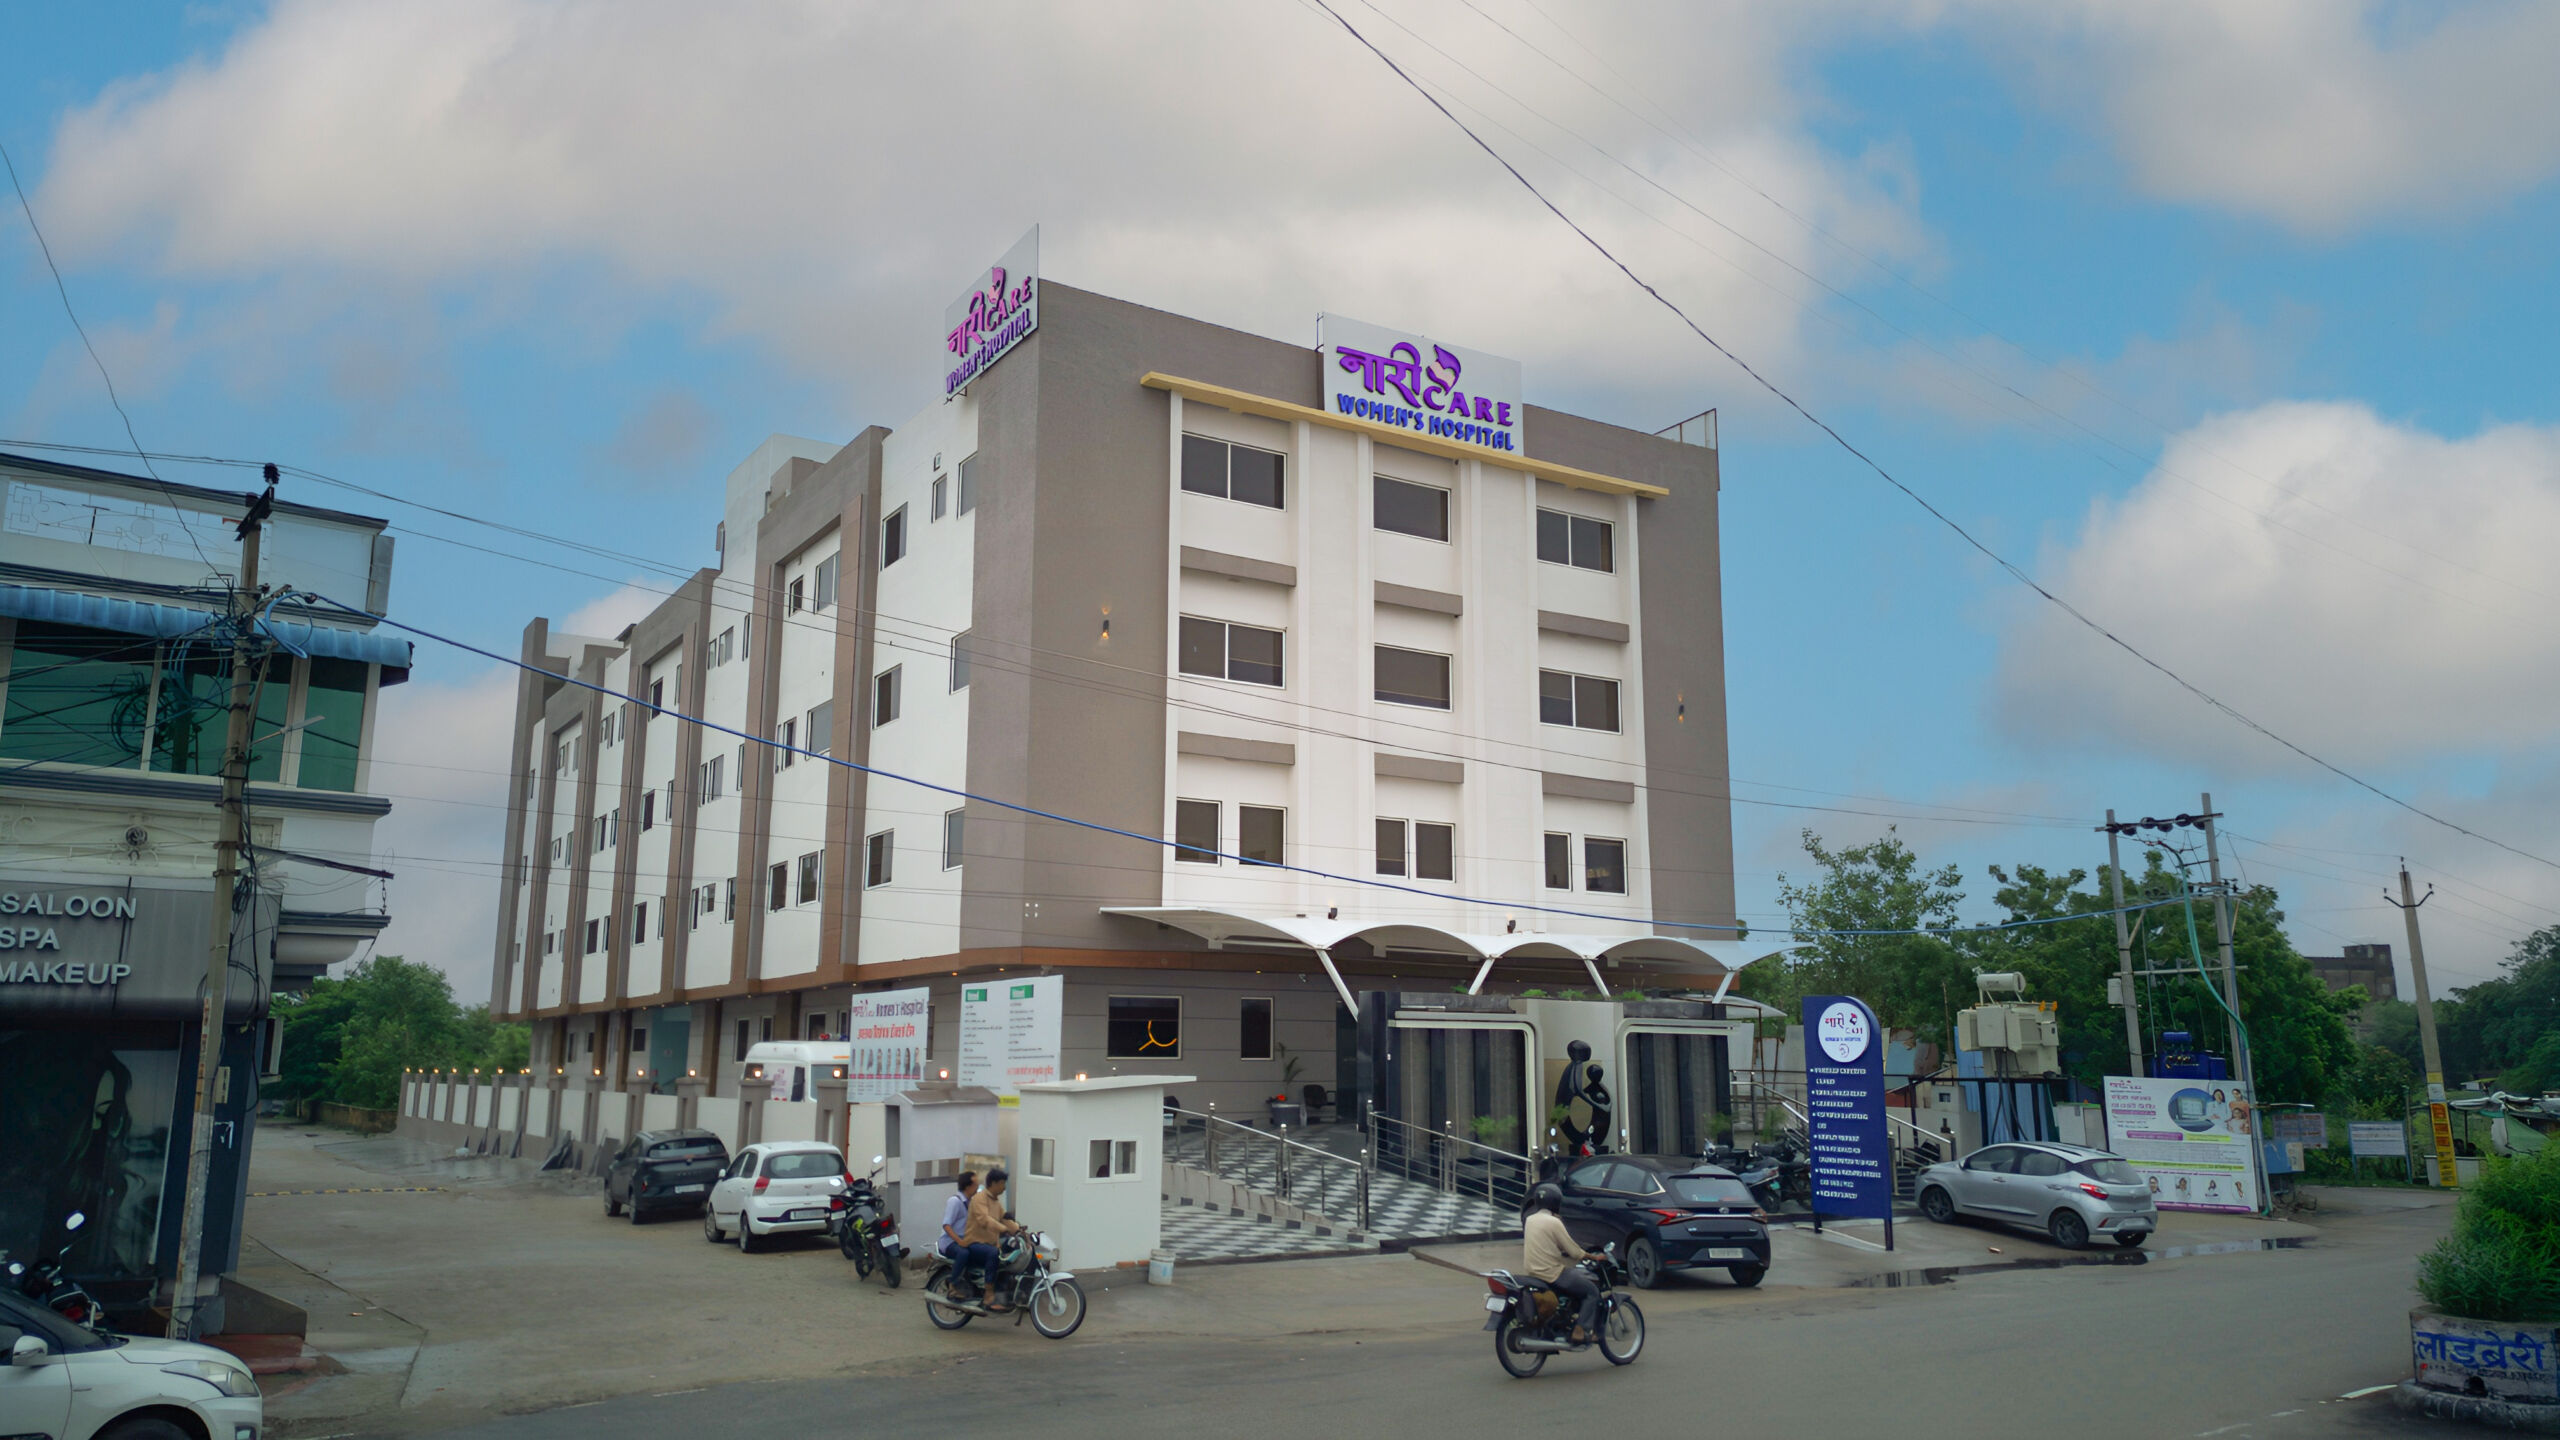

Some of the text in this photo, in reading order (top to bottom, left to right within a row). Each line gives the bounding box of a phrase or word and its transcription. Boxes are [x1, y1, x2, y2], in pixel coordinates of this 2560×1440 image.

[947, 291, 986, 358] नारी
[985, 276, 1033, 332] CARE
[1336, 342, 1422, 409] नारी
[1337, 393, 1514, 450] WOMEN'S HOSPITAL
[1423, 385, 1514, 427] CARE
[0, 892, 137, 919] SALOON
[0, 927, 60, 950] SPA
[0, 961, 131, 985] MAKEUP
